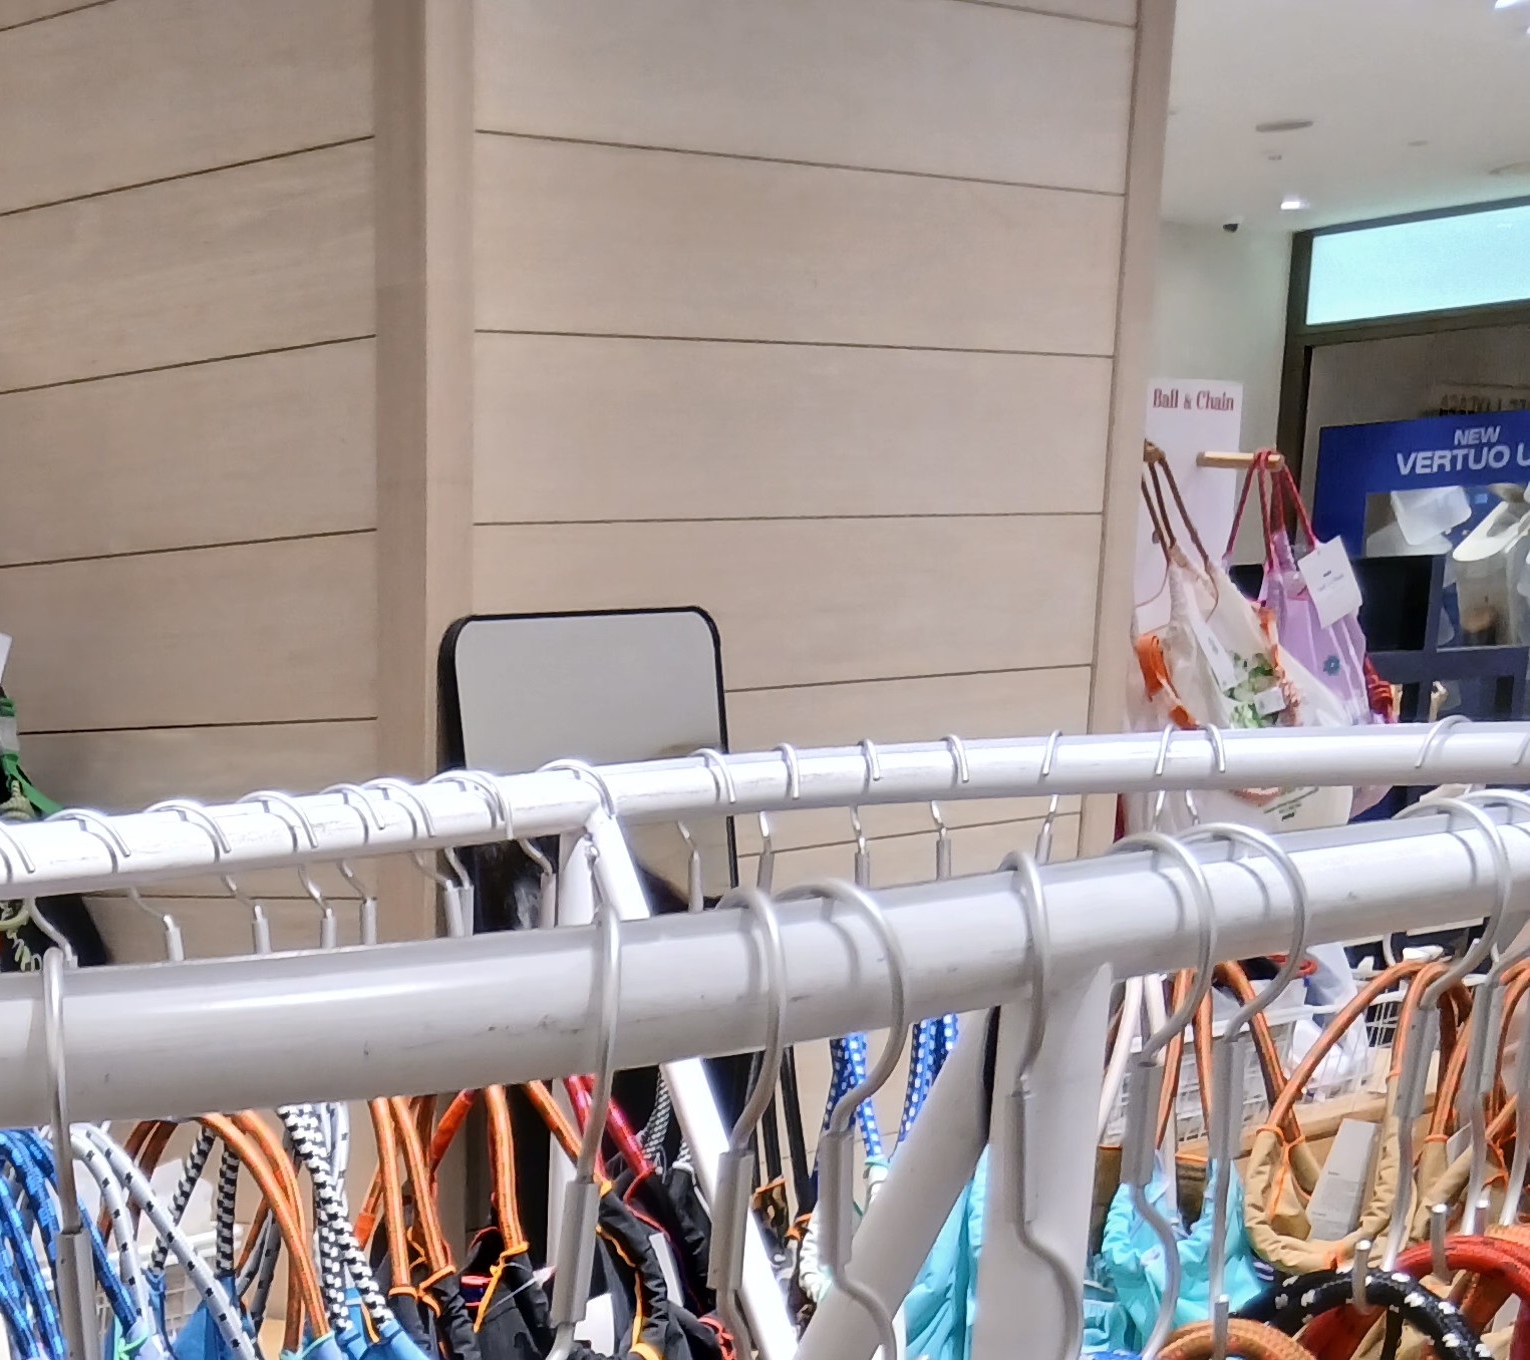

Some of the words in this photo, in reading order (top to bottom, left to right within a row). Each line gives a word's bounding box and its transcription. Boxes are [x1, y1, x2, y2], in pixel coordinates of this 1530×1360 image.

[1153, 388, 1179, 408] Ball
[1183, 392, 1193, 410] &
[1196, 389, 1234, 411] Chain
[1454, 425, 1501, 446] NEW
[1396, 445, 1511, 476] VERTUO
